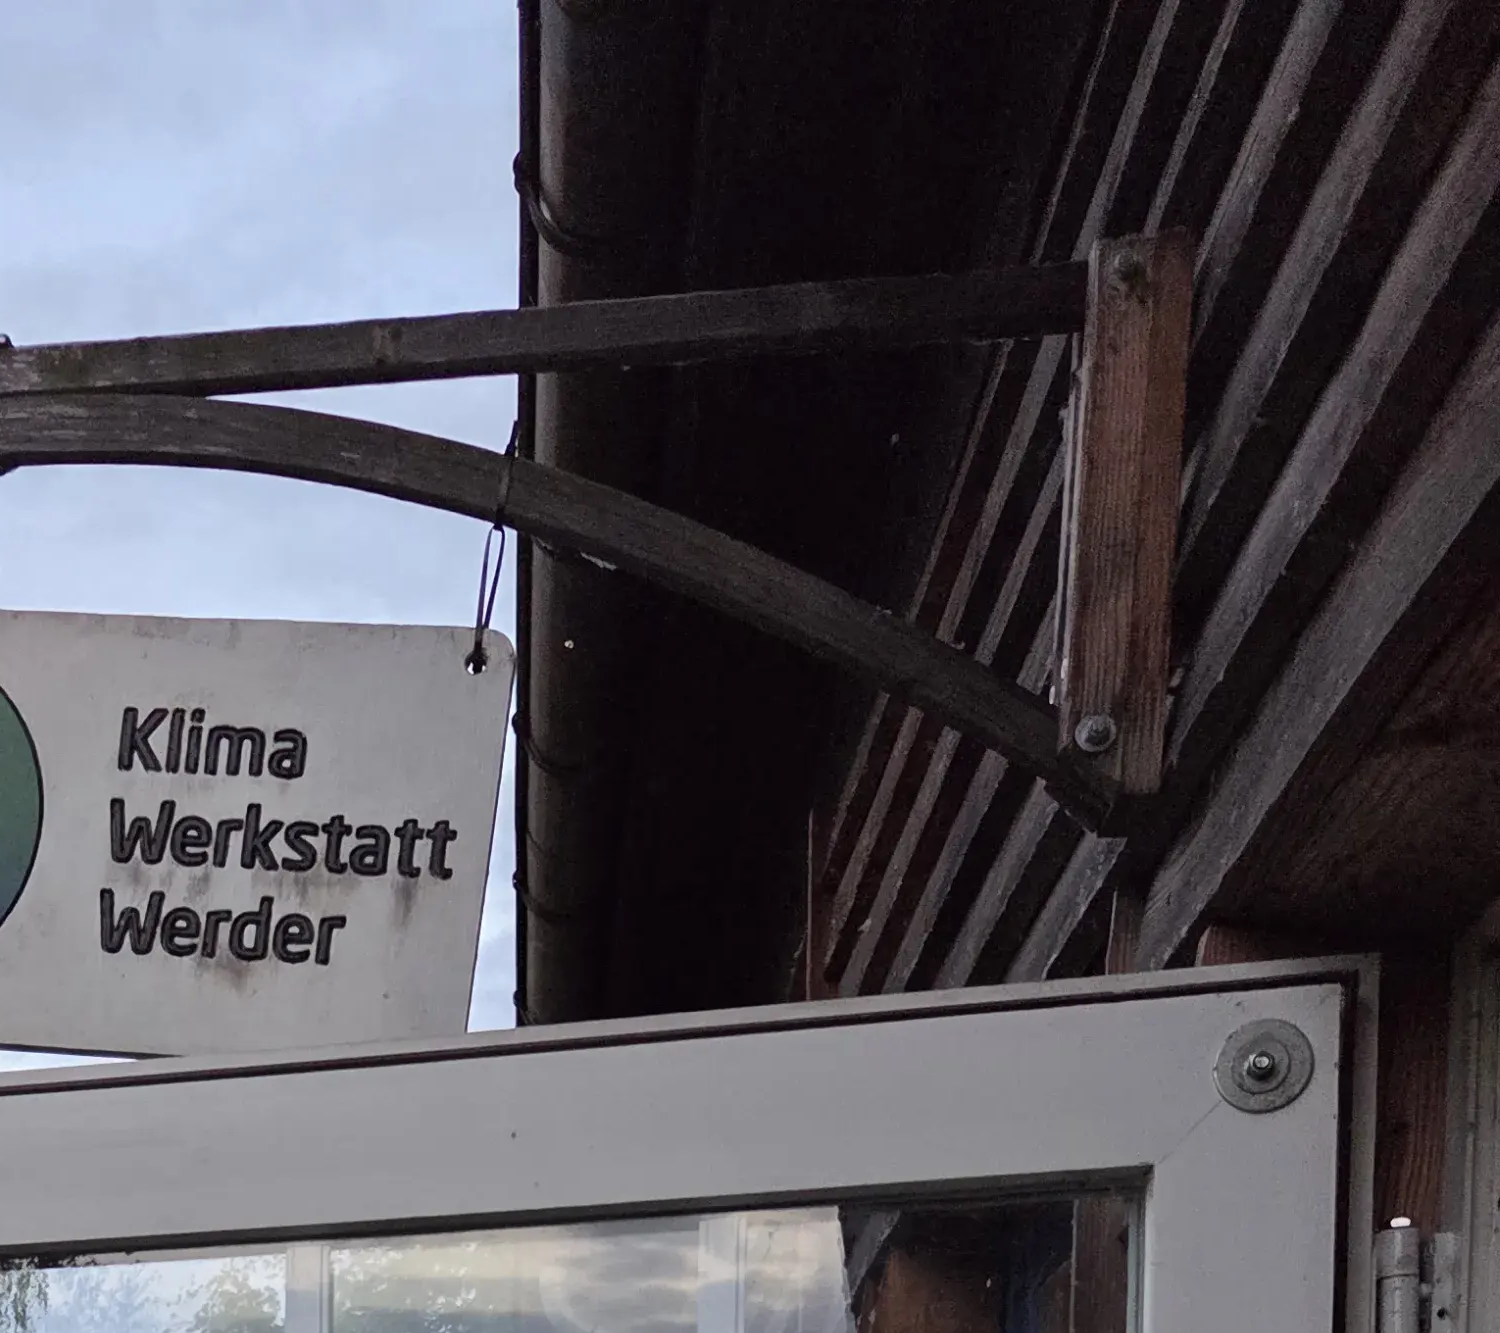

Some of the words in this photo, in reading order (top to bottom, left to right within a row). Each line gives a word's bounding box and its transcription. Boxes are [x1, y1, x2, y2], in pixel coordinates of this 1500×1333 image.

[117, 707, 309, 780] Klima
[108, 798, 456, 880] Werkstatt
[99, 888, 347, 967] Werder
